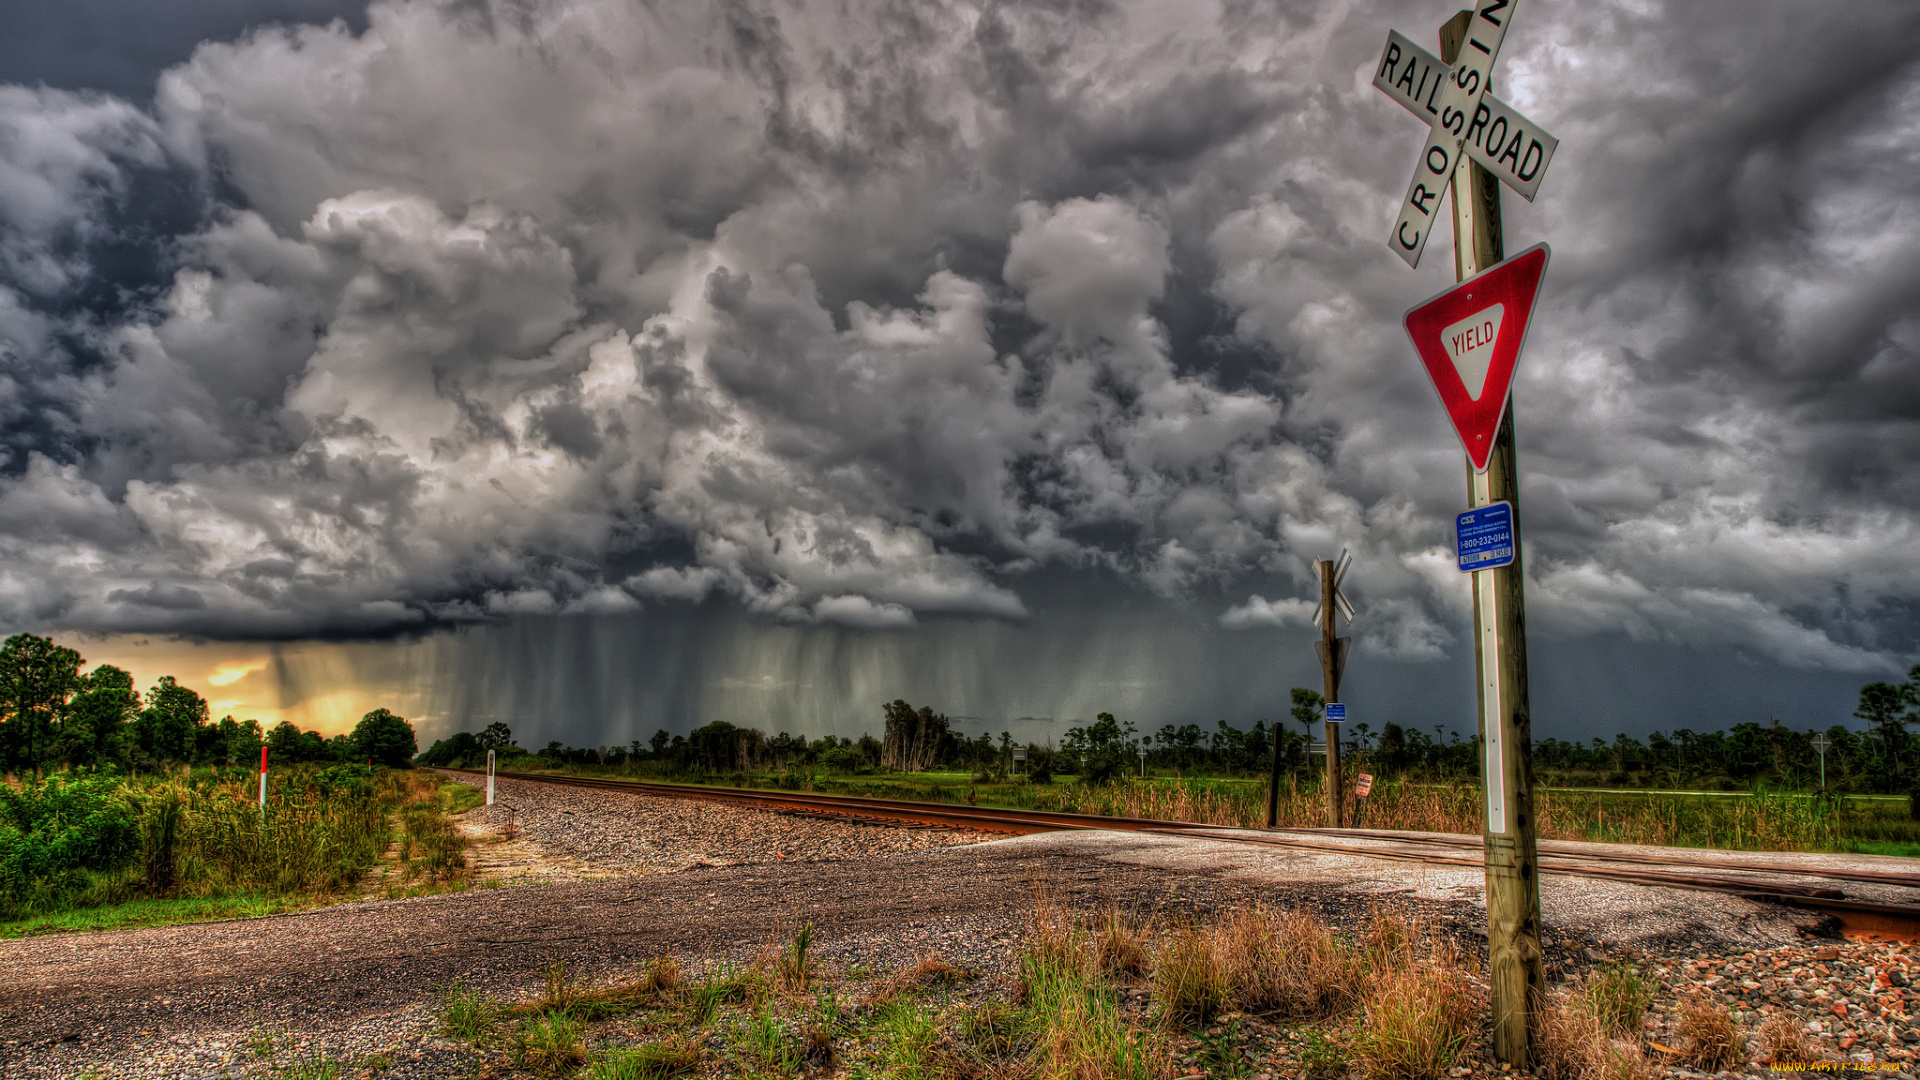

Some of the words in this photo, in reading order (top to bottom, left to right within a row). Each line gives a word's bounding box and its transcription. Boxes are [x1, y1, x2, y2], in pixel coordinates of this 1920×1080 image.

[1380, 42, 1442, 116] RAIL
[1466, 102, 1544, 182] ROAD
[1452, 321, 1493, 356] YIELD
[1460, 515, 1475, 525] CSX
[1460, 532, 1509, 549] 1-800-232-0144
